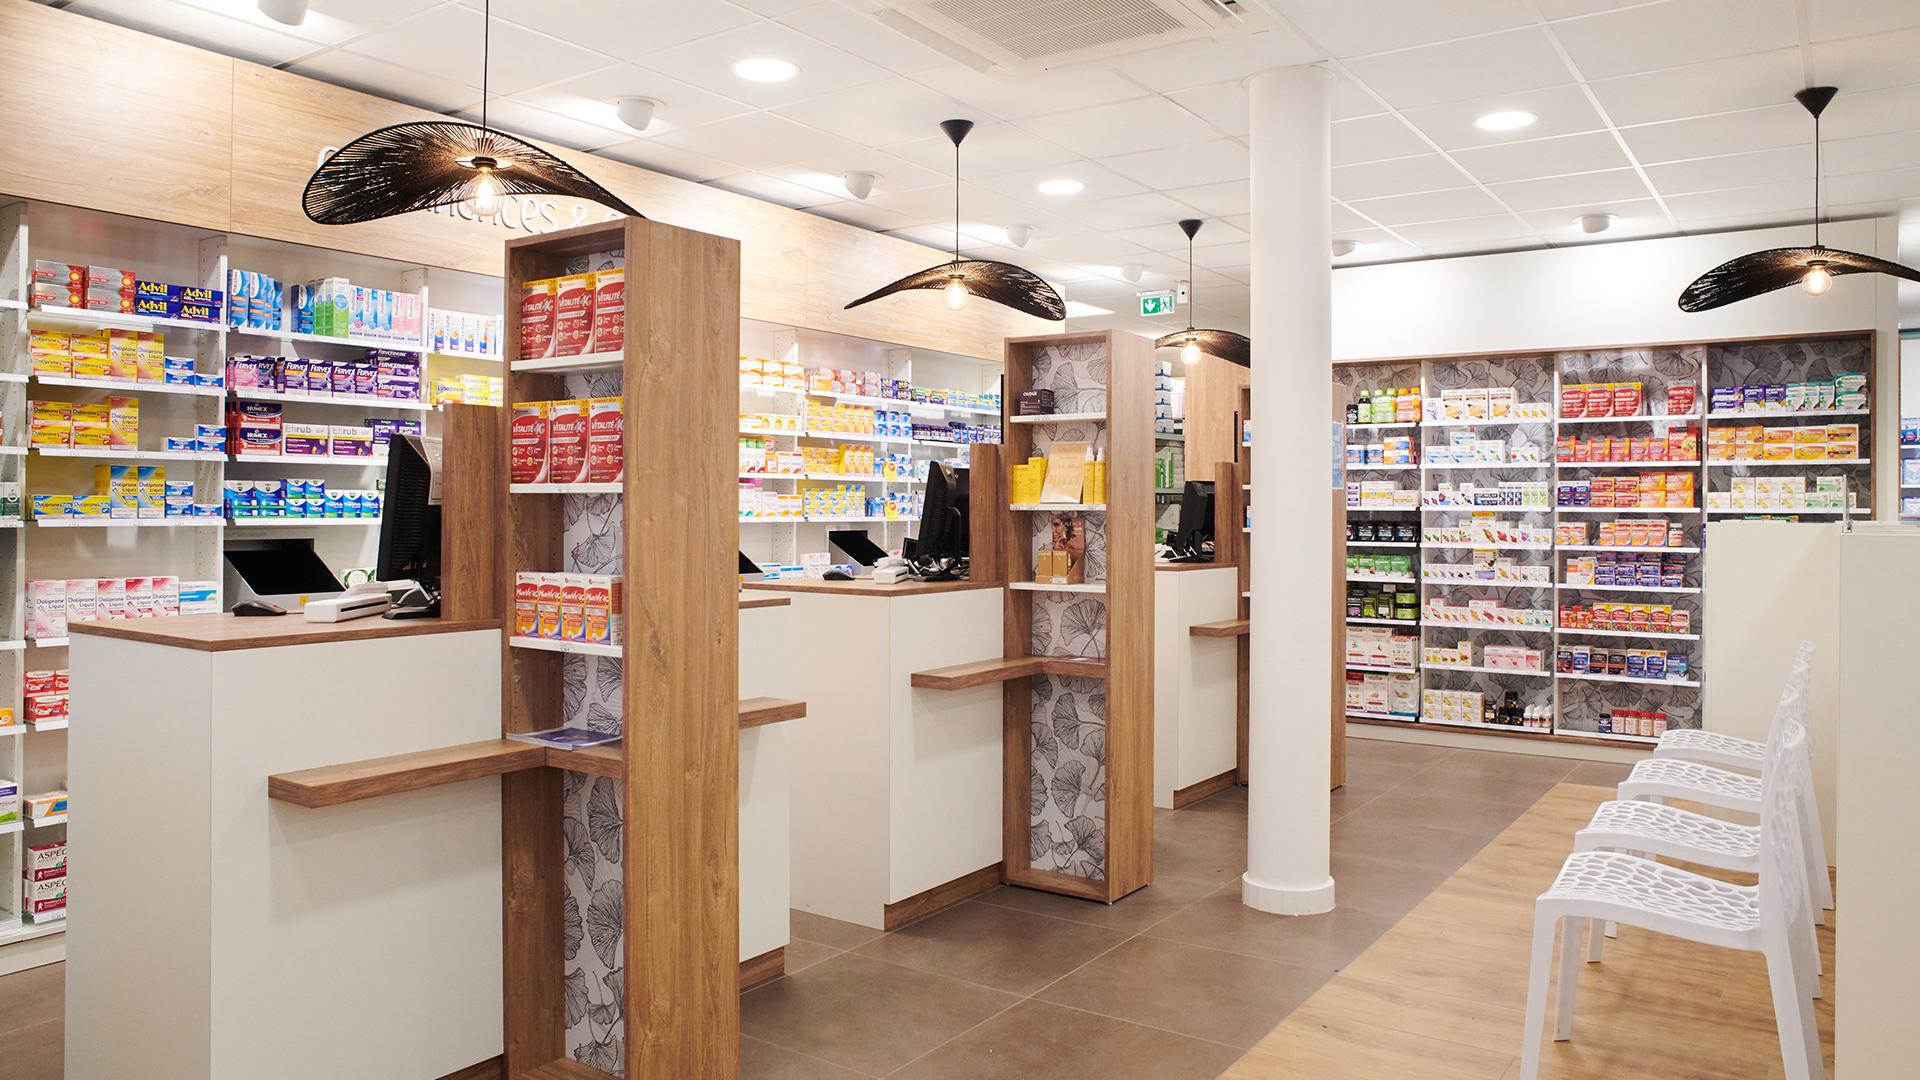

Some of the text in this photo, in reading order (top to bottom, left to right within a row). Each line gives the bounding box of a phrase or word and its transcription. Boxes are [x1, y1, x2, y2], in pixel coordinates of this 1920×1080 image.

[138, 282, 168, 293] Advil
[184, 288, 212, 299] Advil
[138, 300, 168, 312] Advil
[181, 305, 210, 316] Advil
[235, 362, 258, 372] FERVEX
[258, 362, 275, 370] RVEX
[286, 362, 308, 372] FERVEX
[310, 364, 332, 373] FERVEX
[334, 366, 356, 376] FERVEX
[357, 368, 378, 377] FERVEX
[112, 412, 137, 420] Doliprane
[286, 424, 312, 434] Efirub
[332, 426, 358, 436] Efirub
